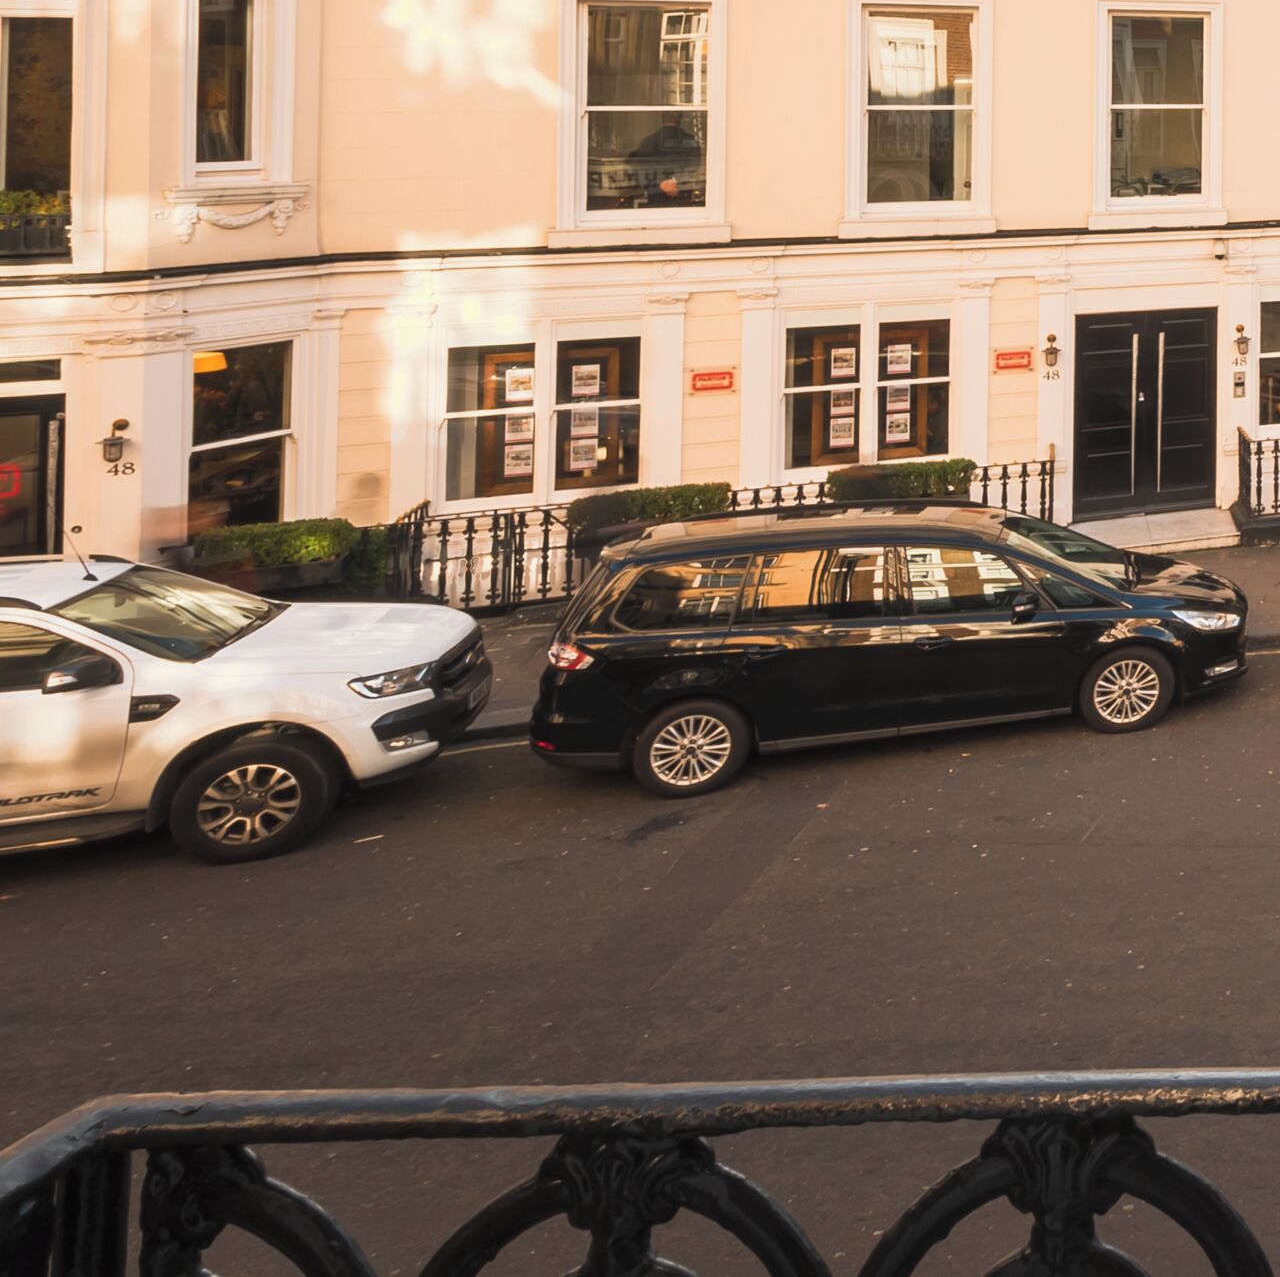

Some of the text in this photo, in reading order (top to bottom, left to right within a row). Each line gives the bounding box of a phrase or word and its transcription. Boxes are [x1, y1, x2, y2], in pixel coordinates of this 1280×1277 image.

[1231, 356, 1248, 367] 48
[1043, 369, 1060, 381] 48
[106, 462, 136, 476] 48
[0, 786, 102, 807] LDTRAK
